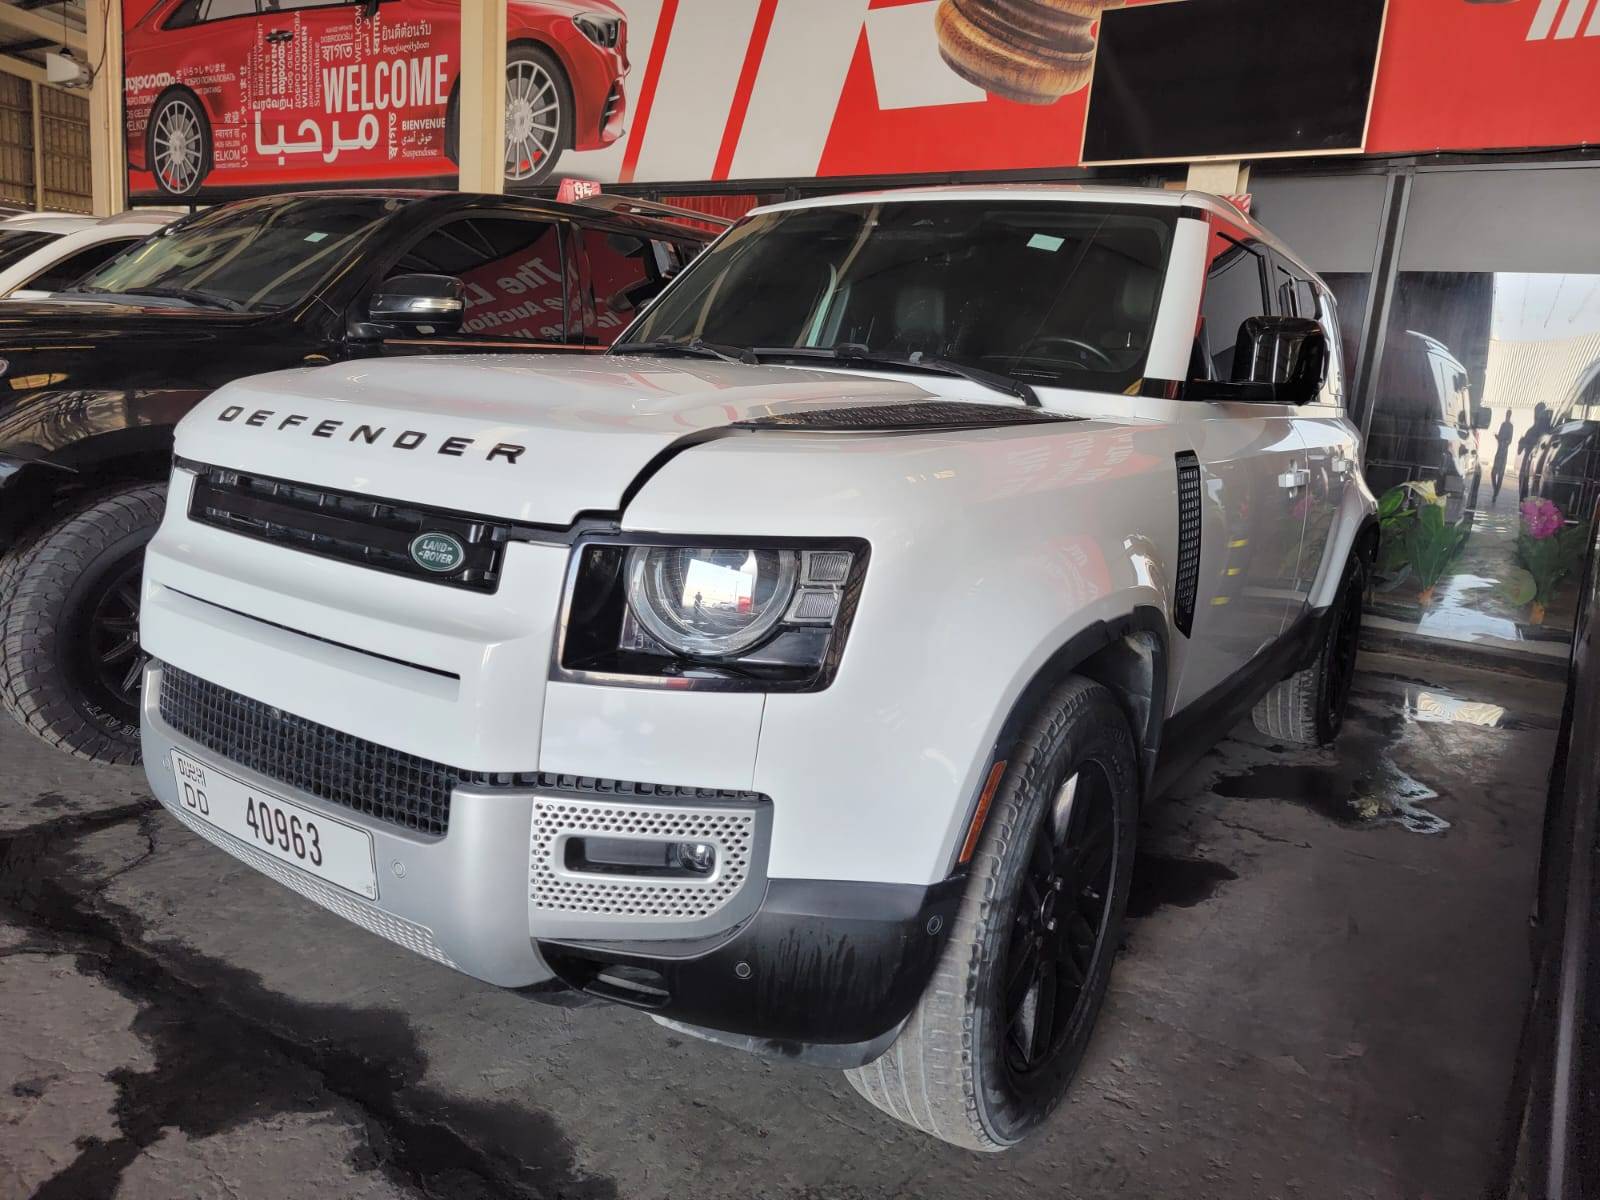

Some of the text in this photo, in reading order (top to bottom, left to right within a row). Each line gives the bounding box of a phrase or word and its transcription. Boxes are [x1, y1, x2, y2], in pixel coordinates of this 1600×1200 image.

[322, 54, 449, 114] WELCOME
[254, 111, 380, 166] مرحبا
[401, 117, 446, 131] BIENVENUE
[214, 150, 240, 162] ELKOM
[217, 405, 526, 464] DEFENDER
[184, 782, 209, 816] DD
[246, 797, 322, 866] 40963
